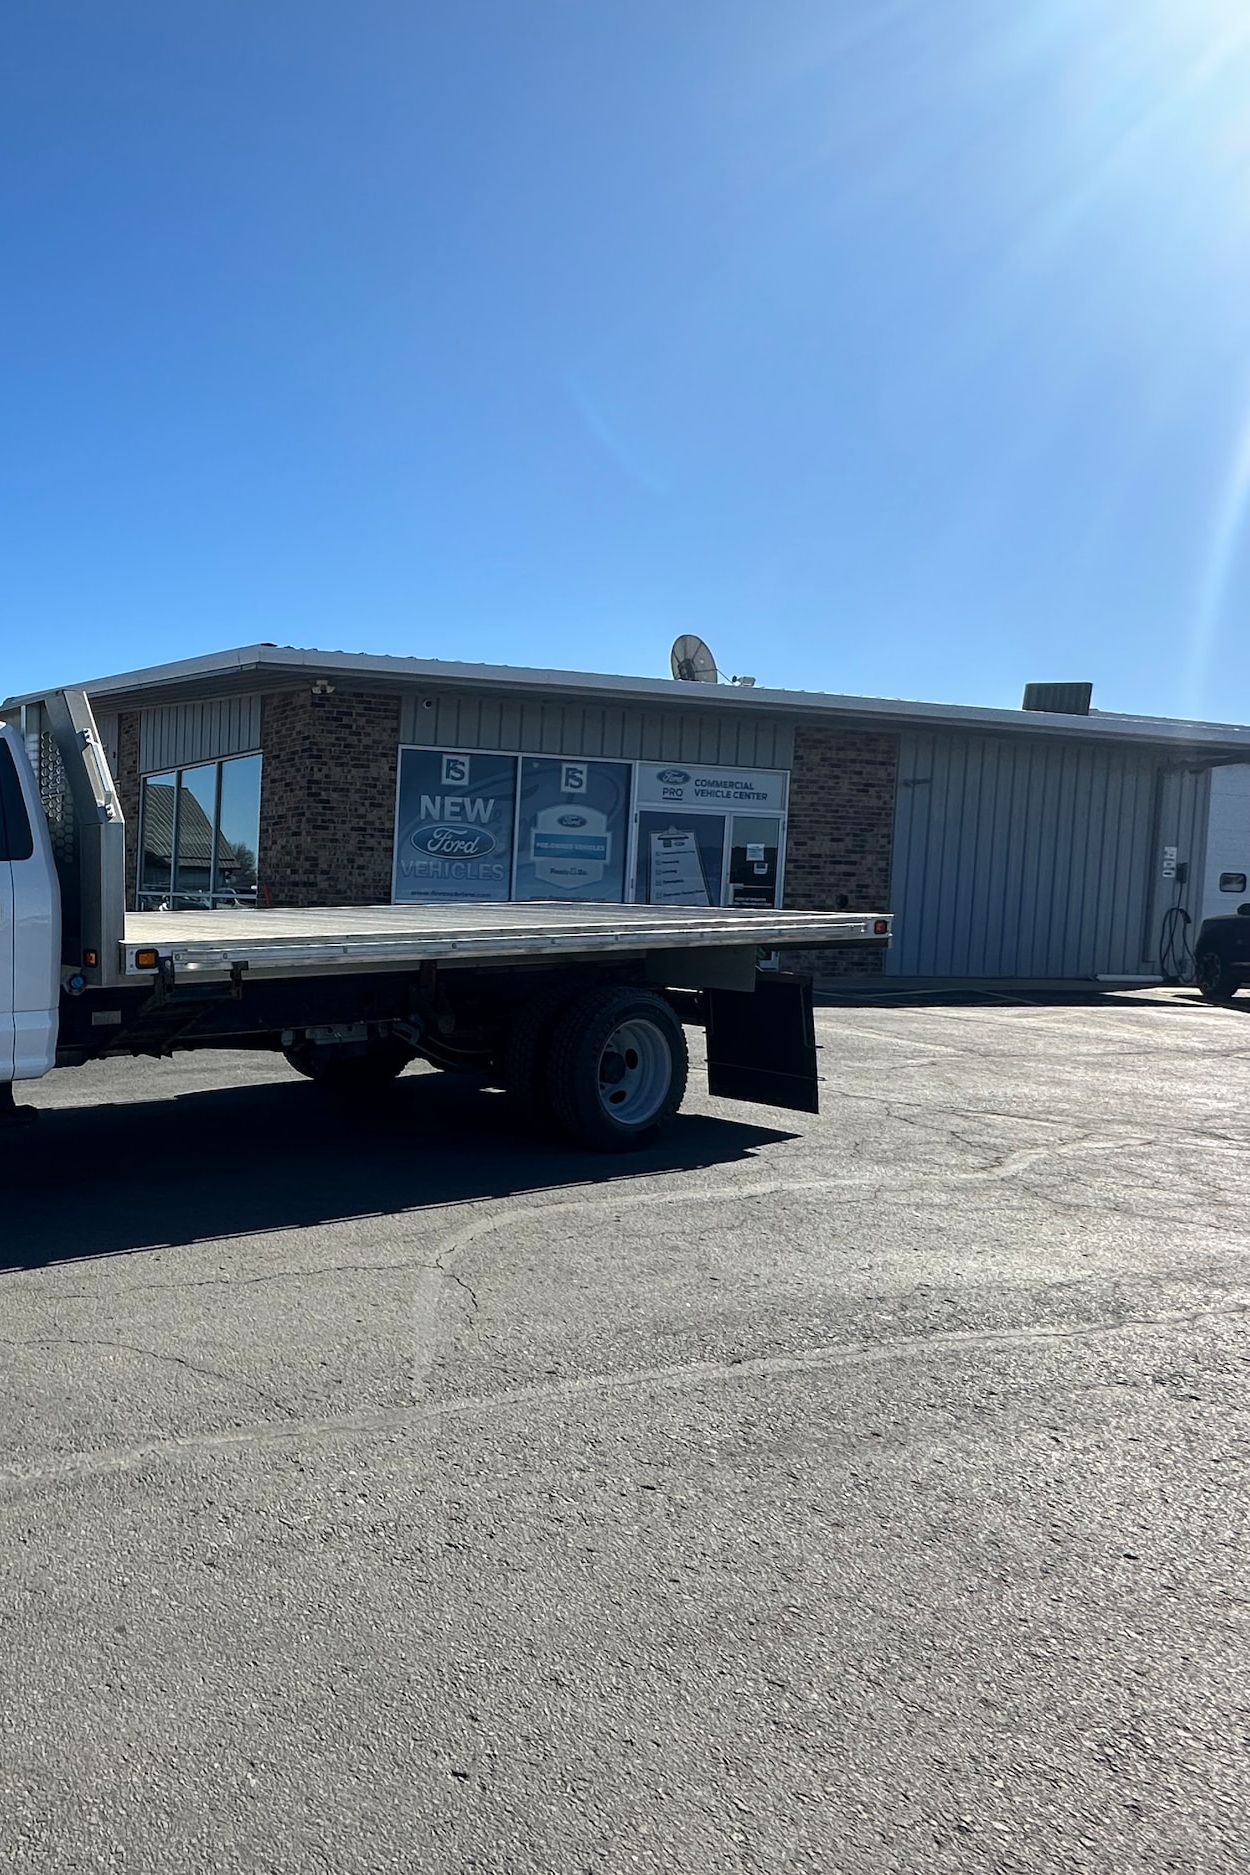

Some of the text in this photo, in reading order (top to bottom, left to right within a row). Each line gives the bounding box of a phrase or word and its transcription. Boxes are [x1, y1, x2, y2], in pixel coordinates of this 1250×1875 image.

[694, 779, 754, 790] COMMERCIAL
[662, 787, 683, 797] PRO
[694, 789, 768, 800] VEHICLE CENTER
[420, 794, 495, 823] NEW
[562, 814, 581, 826] Ford
[427, 827, 480, 854] Ford
[400, 860, 504, 880] VEHICLES
